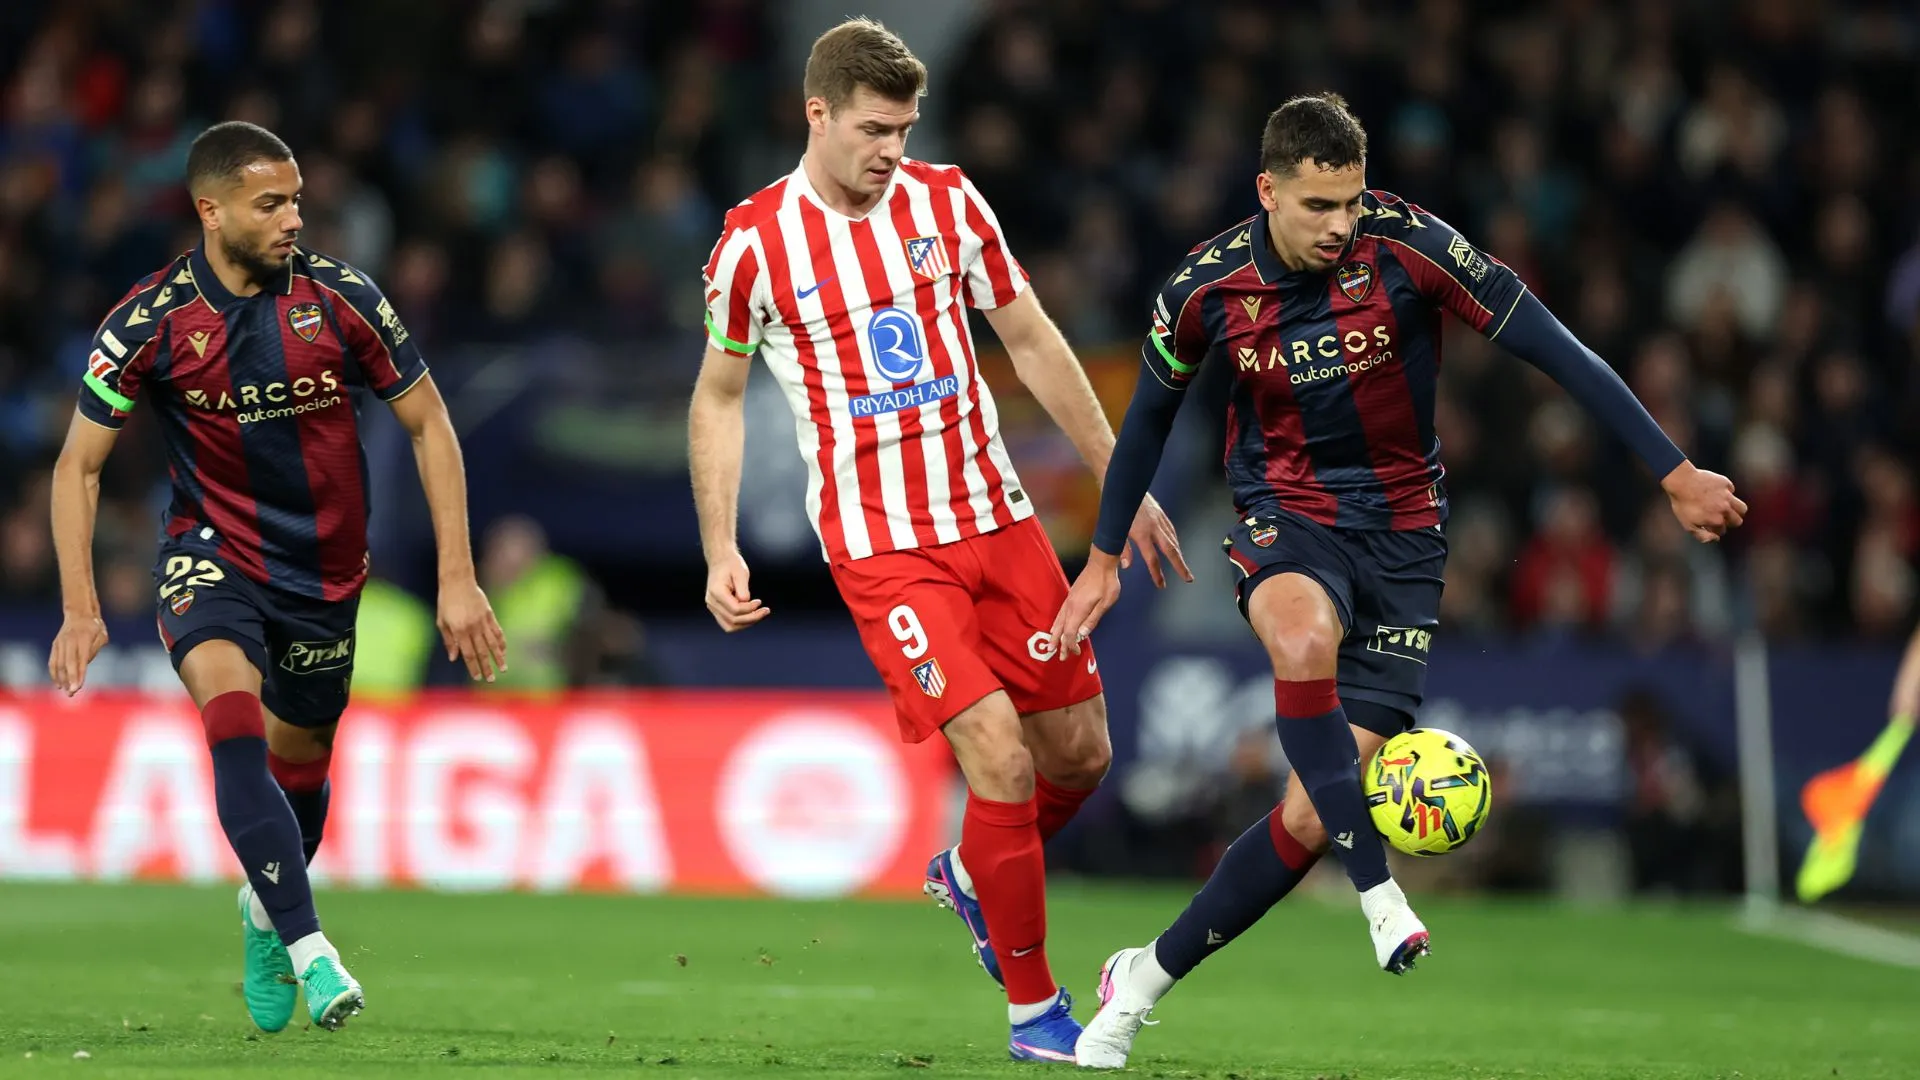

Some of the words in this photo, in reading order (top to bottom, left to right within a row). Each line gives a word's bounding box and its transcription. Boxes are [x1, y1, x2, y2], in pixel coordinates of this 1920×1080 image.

[1469, 255, 1483, 278] BLAU
[1475, 261, 1489, 283] HOME
[1238, 325, 1390, 372] MARCOS
[1290, 351, 1393, 385] automoción
[185, 370, 338, 410] MARCOS
[853, 386, 924, 416] RIYADH
[928, 377, 957, 400] AIR
[237, 395, 341, 424] automoción
[159, 555, 225, 600] 22
[887, 604, 929, 660] 9
[301, 638, 351, 667] JYSK
